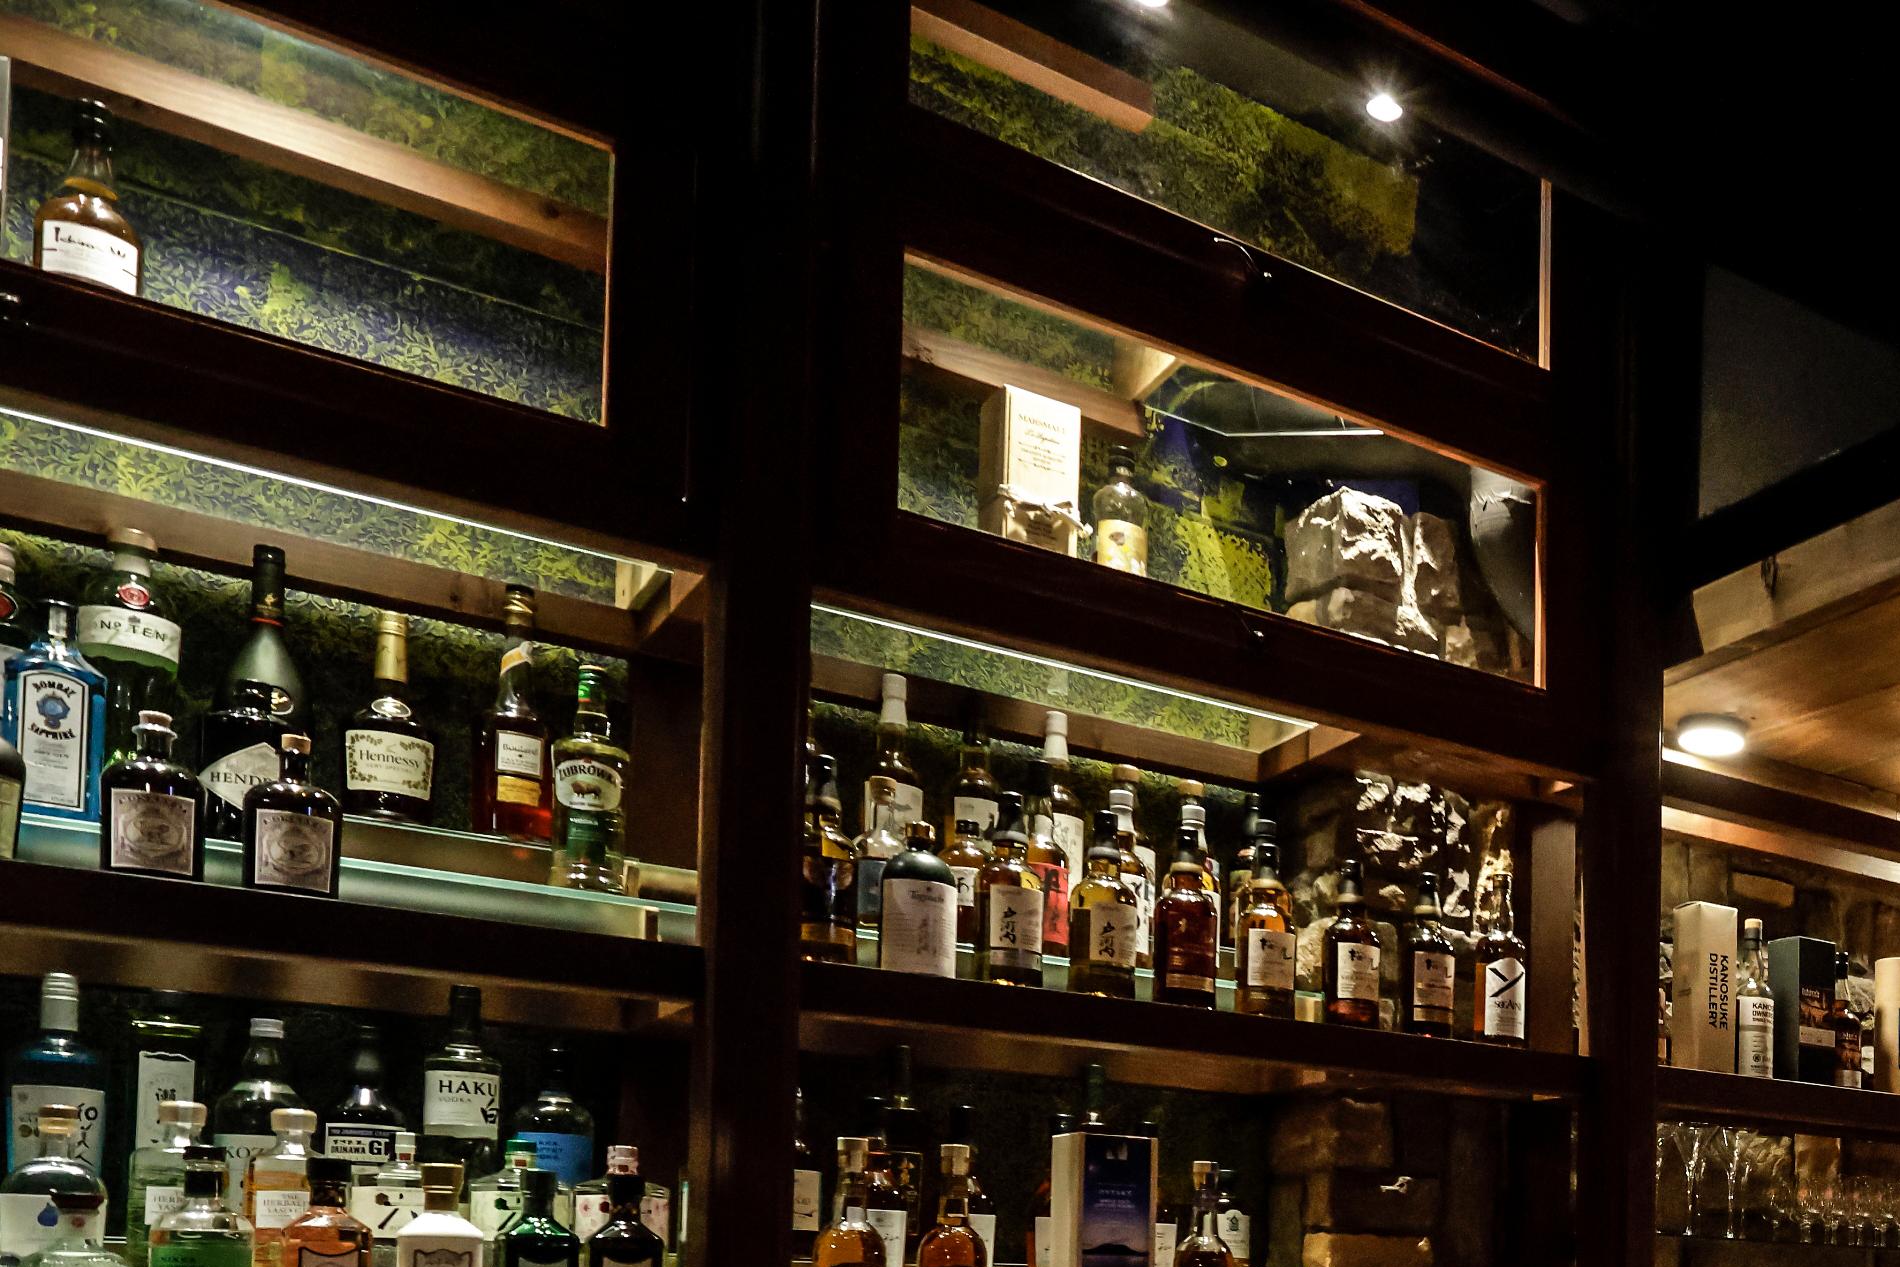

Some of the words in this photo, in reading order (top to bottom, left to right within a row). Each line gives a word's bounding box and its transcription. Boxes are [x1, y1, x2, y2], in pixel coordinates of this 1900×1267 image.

[131, 625, 167, 642] TEN
[31, 680, 77, 699] BOMBAY
[28, 722, 77, 741] SAPPHIRE
[359, 749, 419, 769] Hennessy
[1708, 952, 1719, 1029] DISTILLERY
[1719, 954, 1729, 1031] KANOSUKE
[438, 1079, 498, 1098] HAKU
